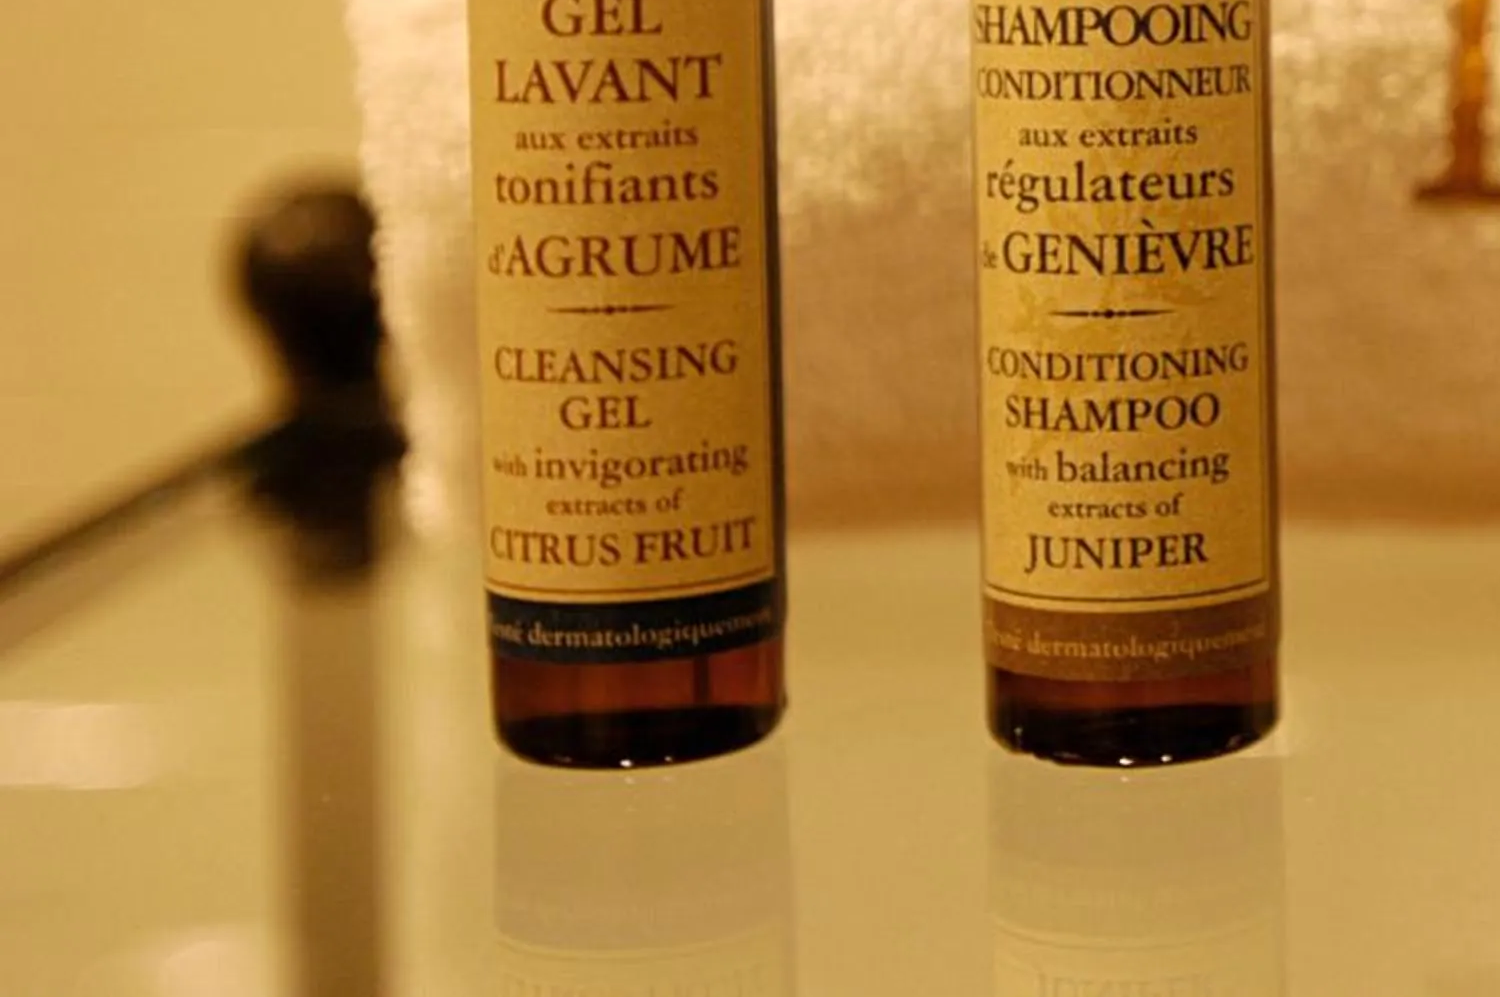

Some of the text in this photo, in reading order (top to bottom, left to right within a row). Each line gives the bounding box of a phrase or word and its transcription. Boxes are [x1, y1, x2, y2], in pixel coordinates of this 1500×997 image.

[974, 0, 1252, 47] SHAMPOOING
[494, 53, 723, 104] LAVANT
[976, 64, 1251, 102] CONDITIONNEUR
[515, 119, 699, 151] aux extraits
[1019, 117, 1199, 147] aux extraits
[495, 161, 719, 204] tonifiants
[986, 159, 1235, 214] régulateurs
[488, 226, 741, 278] d'AGRUME
[1002, 219, 1254, 276] GENIÈVRE
[494, 339, 739, 384] CLEANSING
[988, 341, 1249, 383] CONDITIONING
[559, 395, 653, 431] GEL
[1005, 391, 1221, 433] SHAMPOO
[534, 440, 749, 487] invigorating
[1005, 447, 1230, 484] with balancing
[546, 488, 685, 517] extracts of
[1048, 491, 1185, 518] extracts of
[489, 515, 757, 567] CITRUS FRUIT
[1024, 532, 1209, 574] JUNIPER
